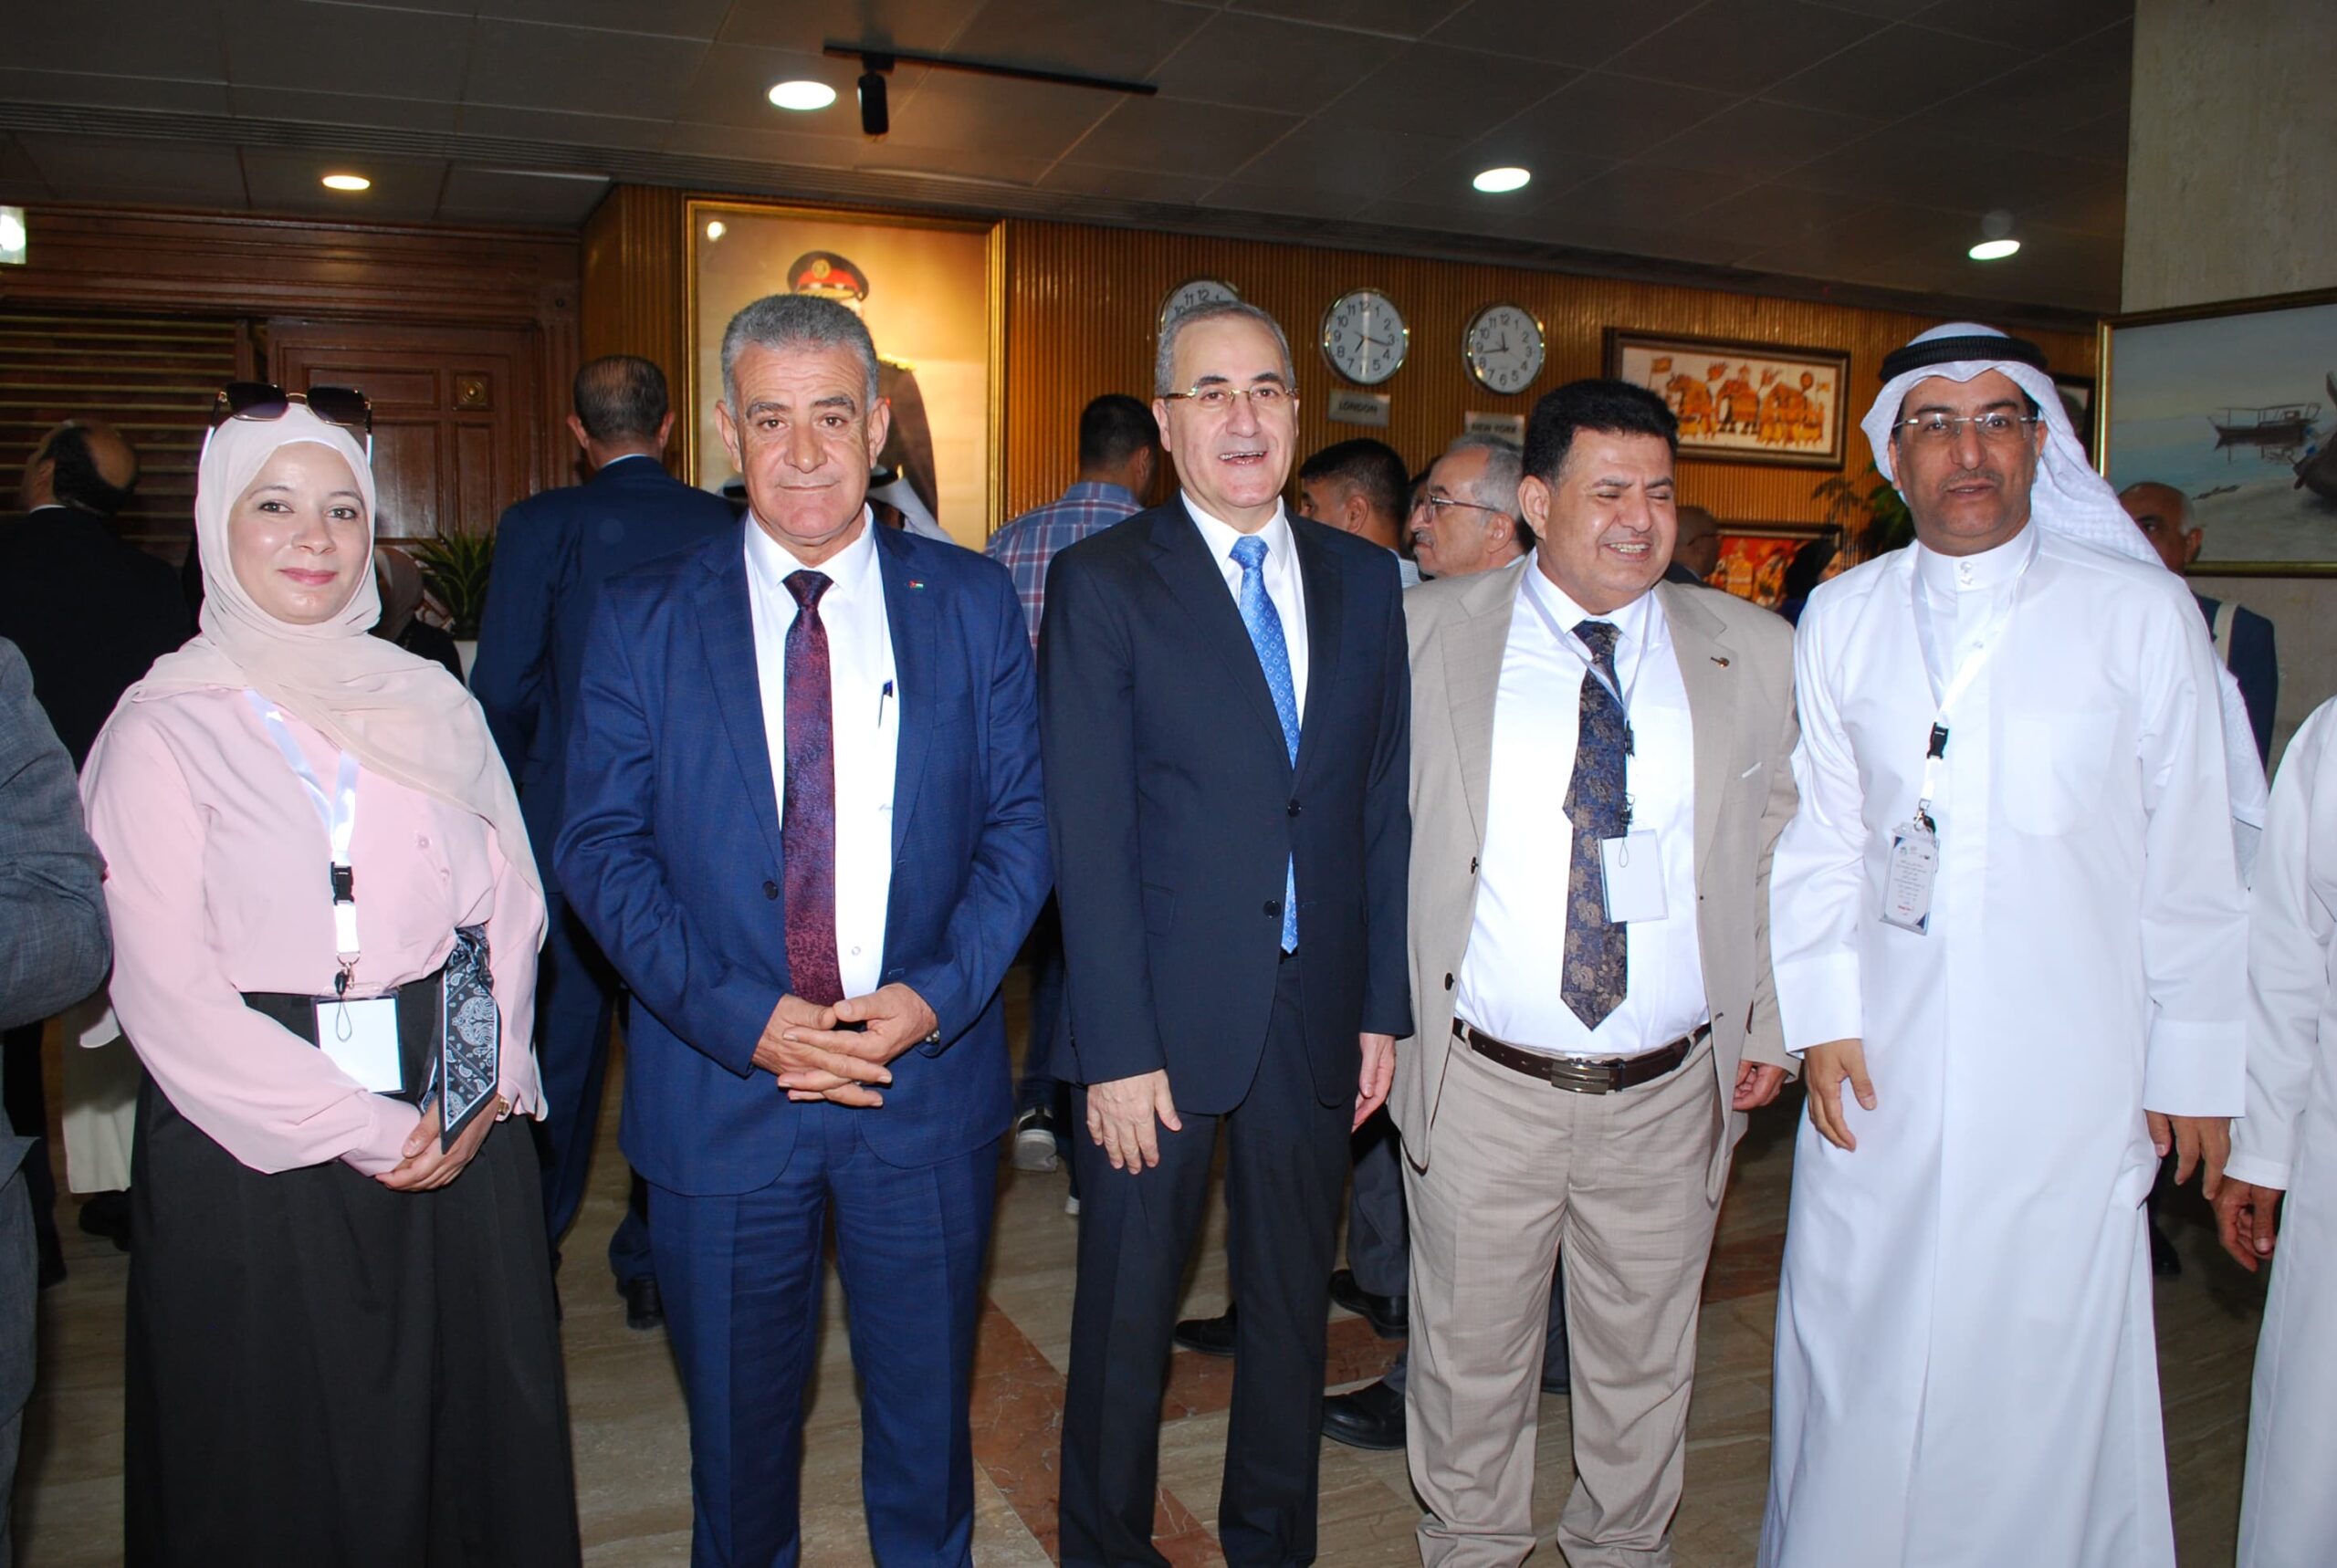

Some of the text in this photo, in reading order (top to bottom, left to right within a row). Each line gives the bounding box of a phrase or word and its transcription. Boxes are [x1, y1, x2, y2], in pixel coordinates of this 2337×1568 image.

[1184, 293, 1194, 306] 11
[1198, 288, 1210, 301] 12
[1347, 304, 1356, 317] 11
[1359, 301, 1370, 312] 12
[1336, 316, 1348, 328] 10
[1384, 318, 1391, 331] 2
[1488, 317, 1497, 329] 11
[1500, 314, 1511, 325] 12
[1333, 330, 1342, 343] 9
[1388, 334, 1395, 347] 3
[1481, 329, 1490, 340] 10
[1522, 330, 1530, 343] 2
[1336, 345, 1345, 359] 8
[1475, 341, 1483, 354] 9
[1525, 345, 1533, 358] 3
[1382, 350, 1390, 360] 4
[1347, 358, 1355, 371] 7
[1372, 360, 1380, 371] 5
[1479, 357, 1487, 369] 8
[1521, 360, 1528, 371] 4
[1488, 369, 1495, 380] 7
[1499, 374, 1507, 386] 6
[1512, 370, 1519, 382] 5
[1338, 402, 1378, 413] LONDON
[1472, 423, 1517, 434] NEW YORK
